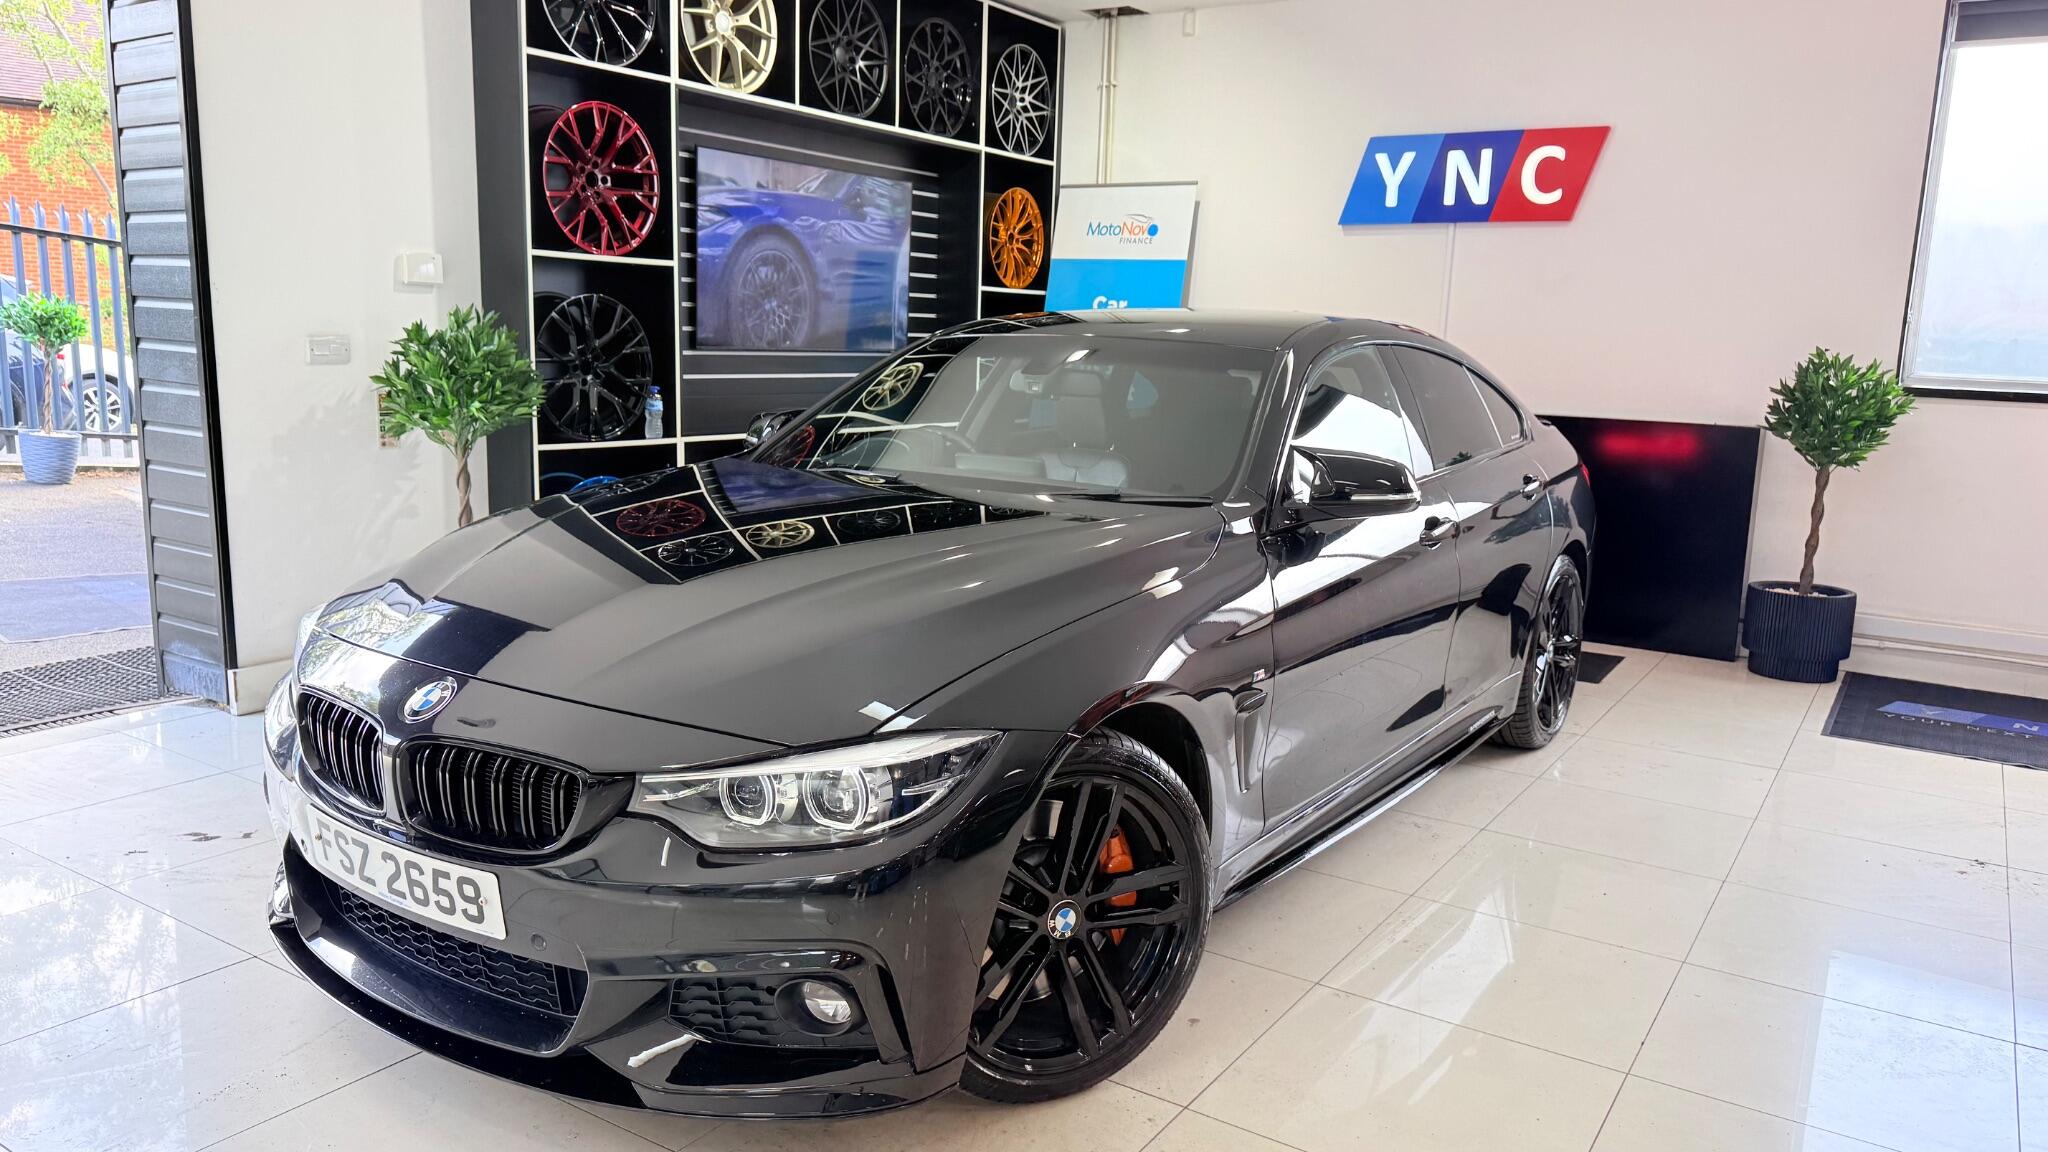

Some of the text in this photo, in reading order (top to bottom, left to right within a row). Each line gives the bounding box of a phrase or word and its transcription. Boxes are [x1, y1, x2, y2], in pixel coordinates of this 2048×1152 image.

[1375, 145, 1566, 207] YNC
[1087, 221, 1159, 237] MotoNovo
[1119, 237, 1153, 245] FINANCE
[1092, 296, 1128, 309] Car
[1884, 713, 2033, 739] YOUR NEXT
[316, 818, 485, 925] FSZ 2659
